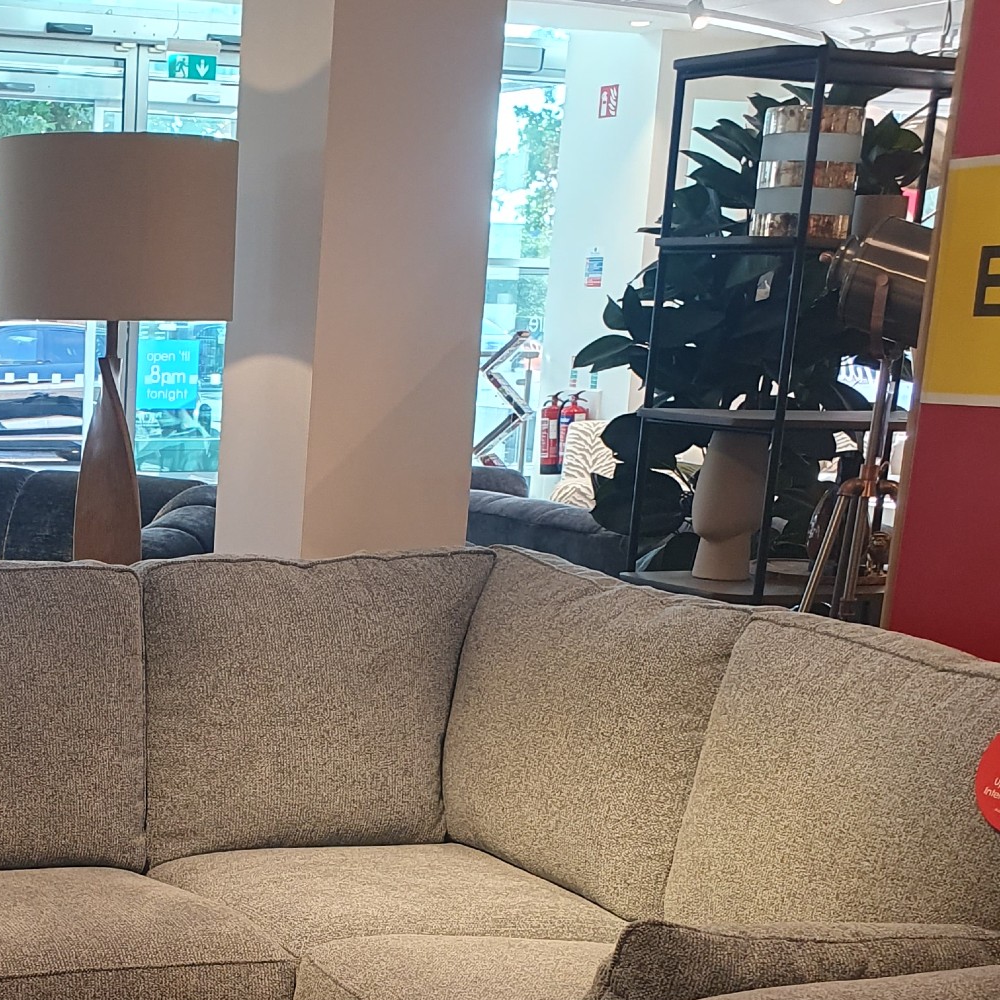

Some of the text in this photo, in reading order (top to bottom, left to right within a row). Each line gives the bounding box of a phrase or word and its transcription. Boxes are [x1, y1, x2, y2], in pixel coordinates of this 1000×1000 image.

[146, 352, 176, 363] open
[150, 364, 186, 387] 8pm
[146, 388, 188, 402] tonight
